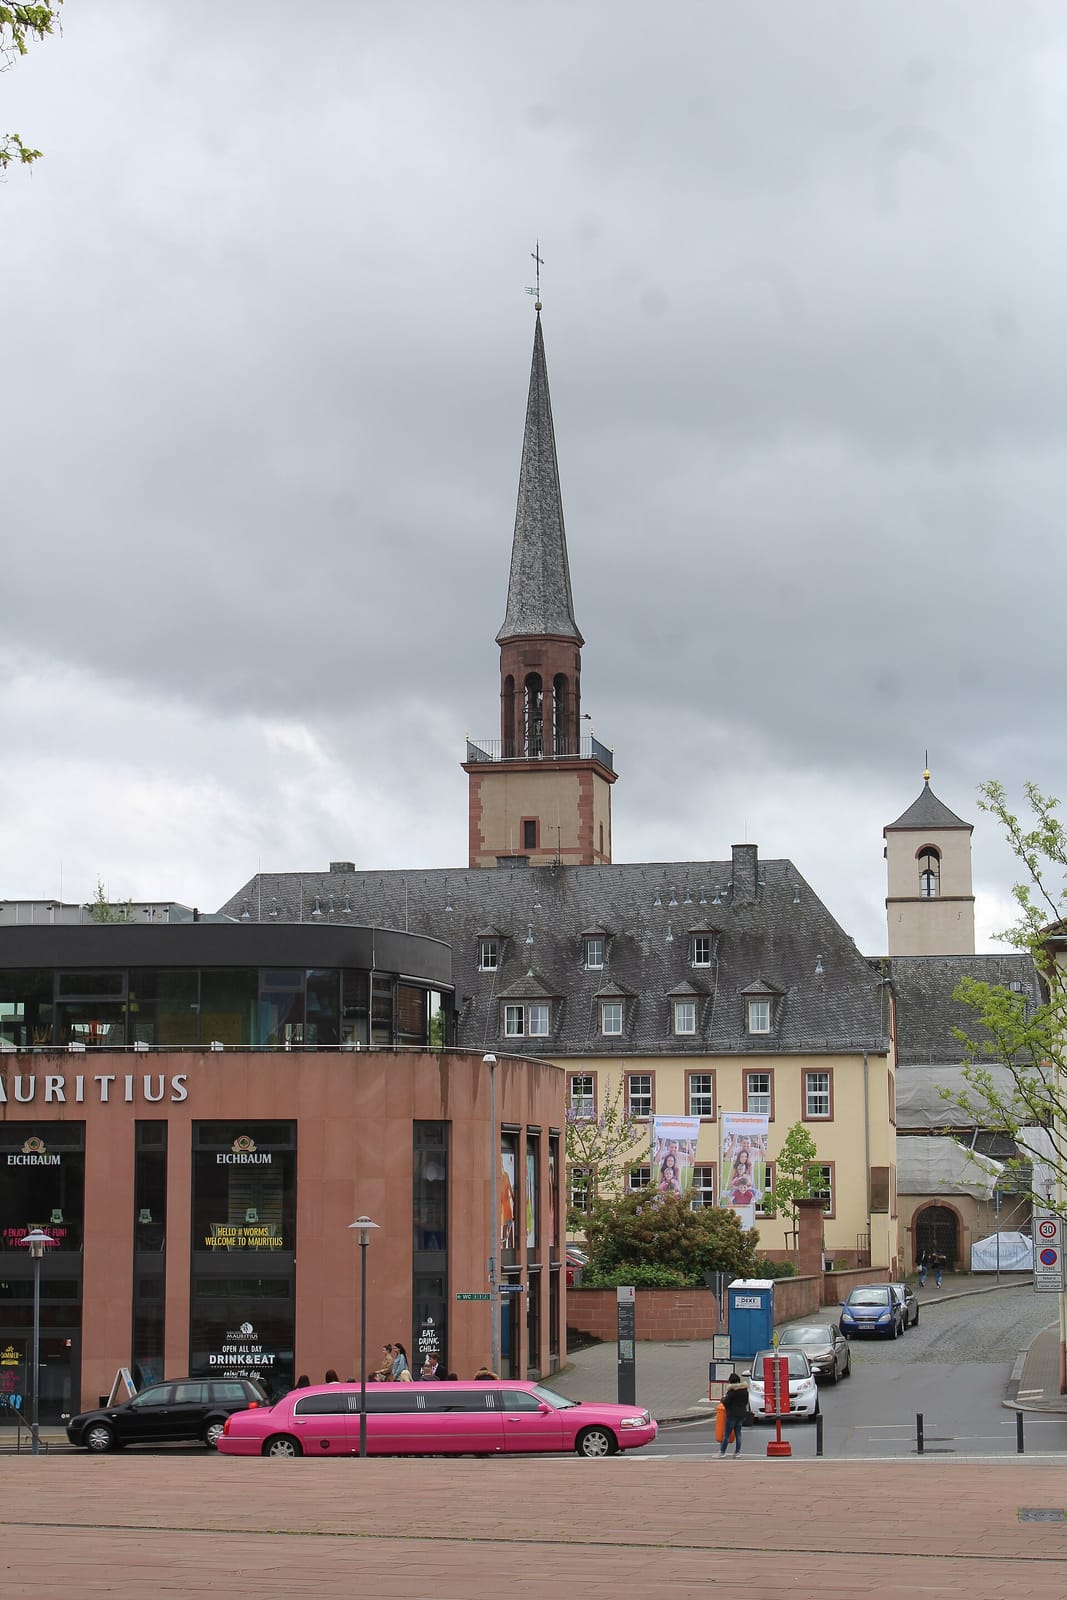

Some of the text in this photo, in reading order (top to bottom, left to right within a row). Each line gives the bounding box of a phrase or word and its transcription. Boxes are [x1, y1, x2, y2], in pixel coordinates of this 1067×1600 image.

[7, 1155, 61, 1165] EICHBAUM
[216, 1153, 272, 1164] EICHBAUM
[217, 1227, 236, 1236] HELLO
[1042, 1225, 1053, 1234] 30
[205, 1237, 283, 1246] WELCOME TO MAURITIUS
[222, 1345, 263, 1353] OPEN ALL DAY
[209, 1354, 276, 1365] DRINK&EAT
